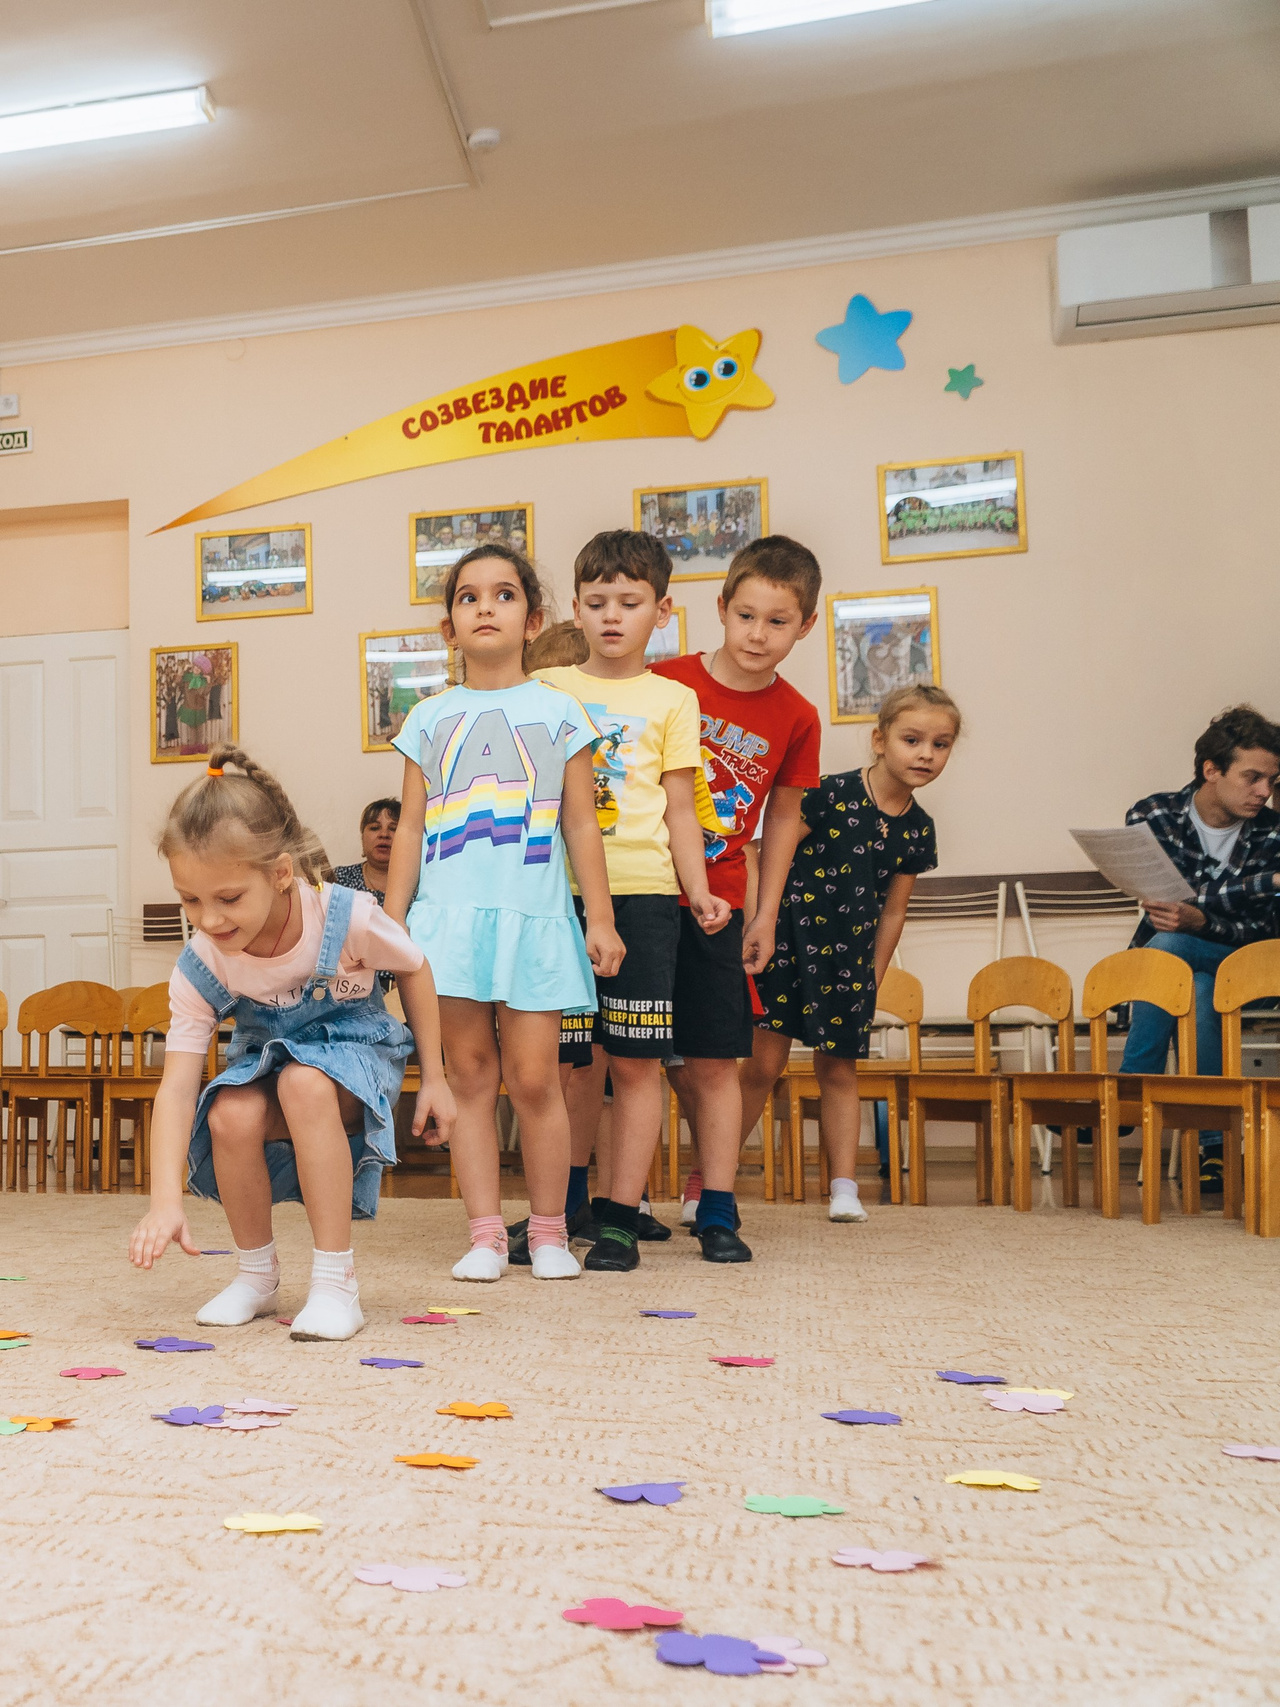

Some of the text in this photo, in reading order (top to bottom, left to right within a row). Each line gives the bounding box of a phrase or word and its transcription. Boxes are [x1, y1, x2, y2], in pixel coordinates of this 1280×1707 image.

[402, 374, 567, 439] СОЗВЕЗДИЕ
[478, 385, 628, 444] ТАЛАНТОВ
[700, 713, 770, 760] DUMP
[721, 748, 769, 784] TRUCK
[608, 997, 628, 1011] REAL
[629, 1000, 653, 1013] KEEP
[654, 1000, 665, 1013] IT
[562, 1018, 583, 1030] REAL
[608, 1010, 628, 1024] KEEP
[628, 1013, 639, 1025] IT
[640, 1013, 665, 1026] REAL
[574, 1031, 583, 1043] IT
[608, 1023, 627, 1038] REAL
[628, 1026, 653, 1040] KEEP
[654, 1027, 666, 1040] IT
